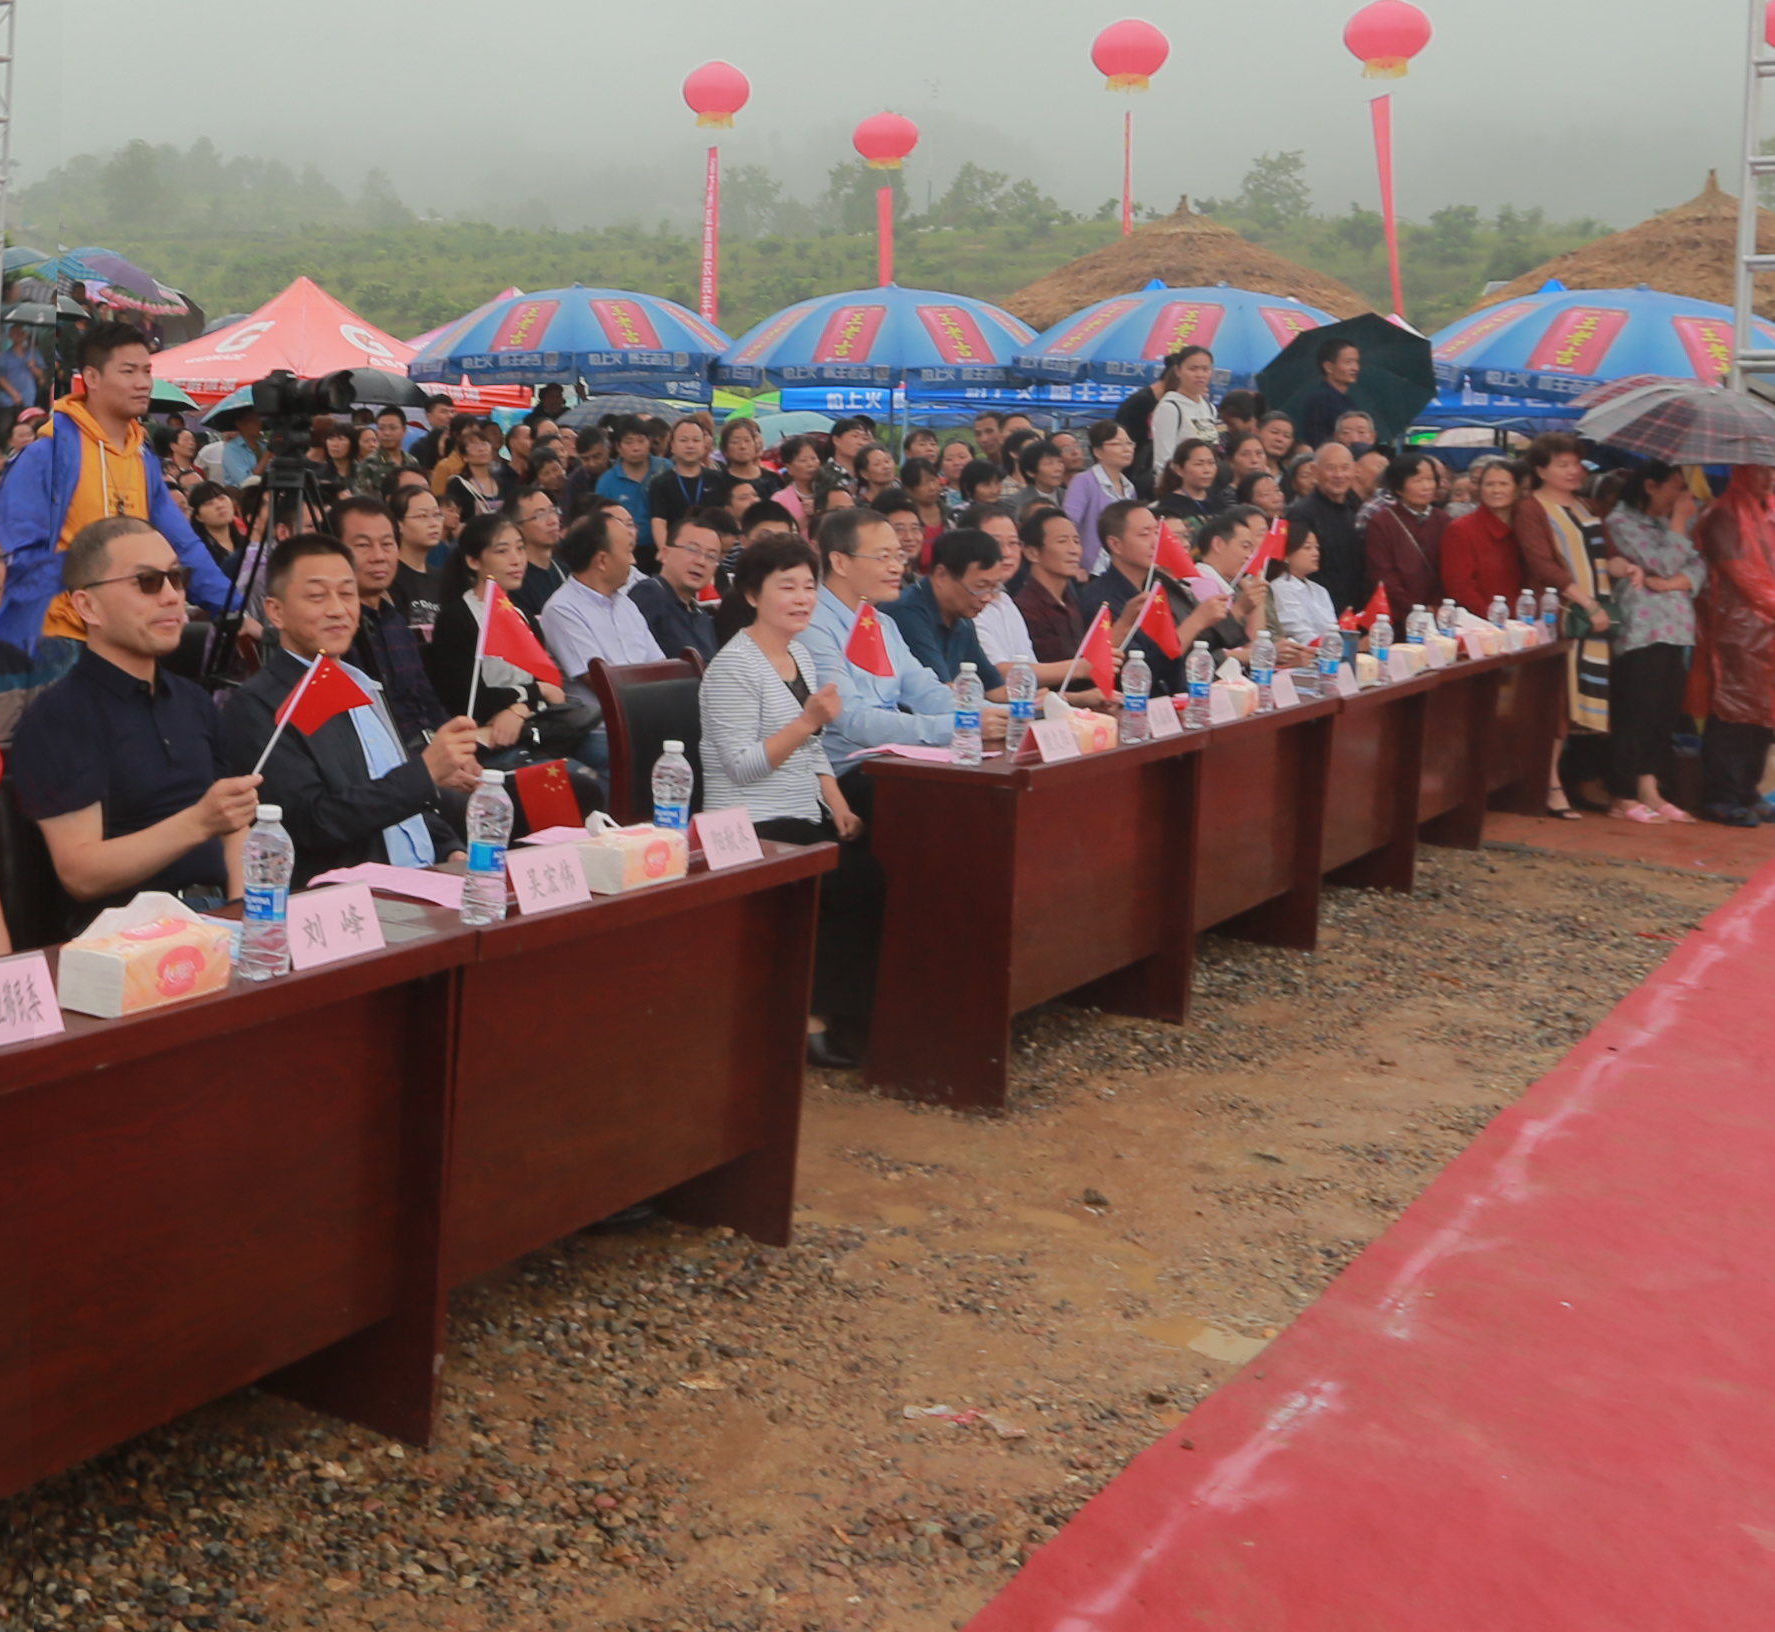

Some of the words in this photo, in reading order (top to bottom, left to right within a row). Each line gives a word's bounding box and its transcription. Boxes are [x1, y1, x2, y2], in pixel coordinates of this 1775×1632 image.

[510, 305, 540, 346] 王老吉
[611, 304, 640, 344] 王老吉
[834, 312, 865, 357] 王老吉
[937, 312, 973, 358] 王老吉
[1555, 315, 1601, 366] 王老吉
[826, 391, 883, 410] 怕上火
